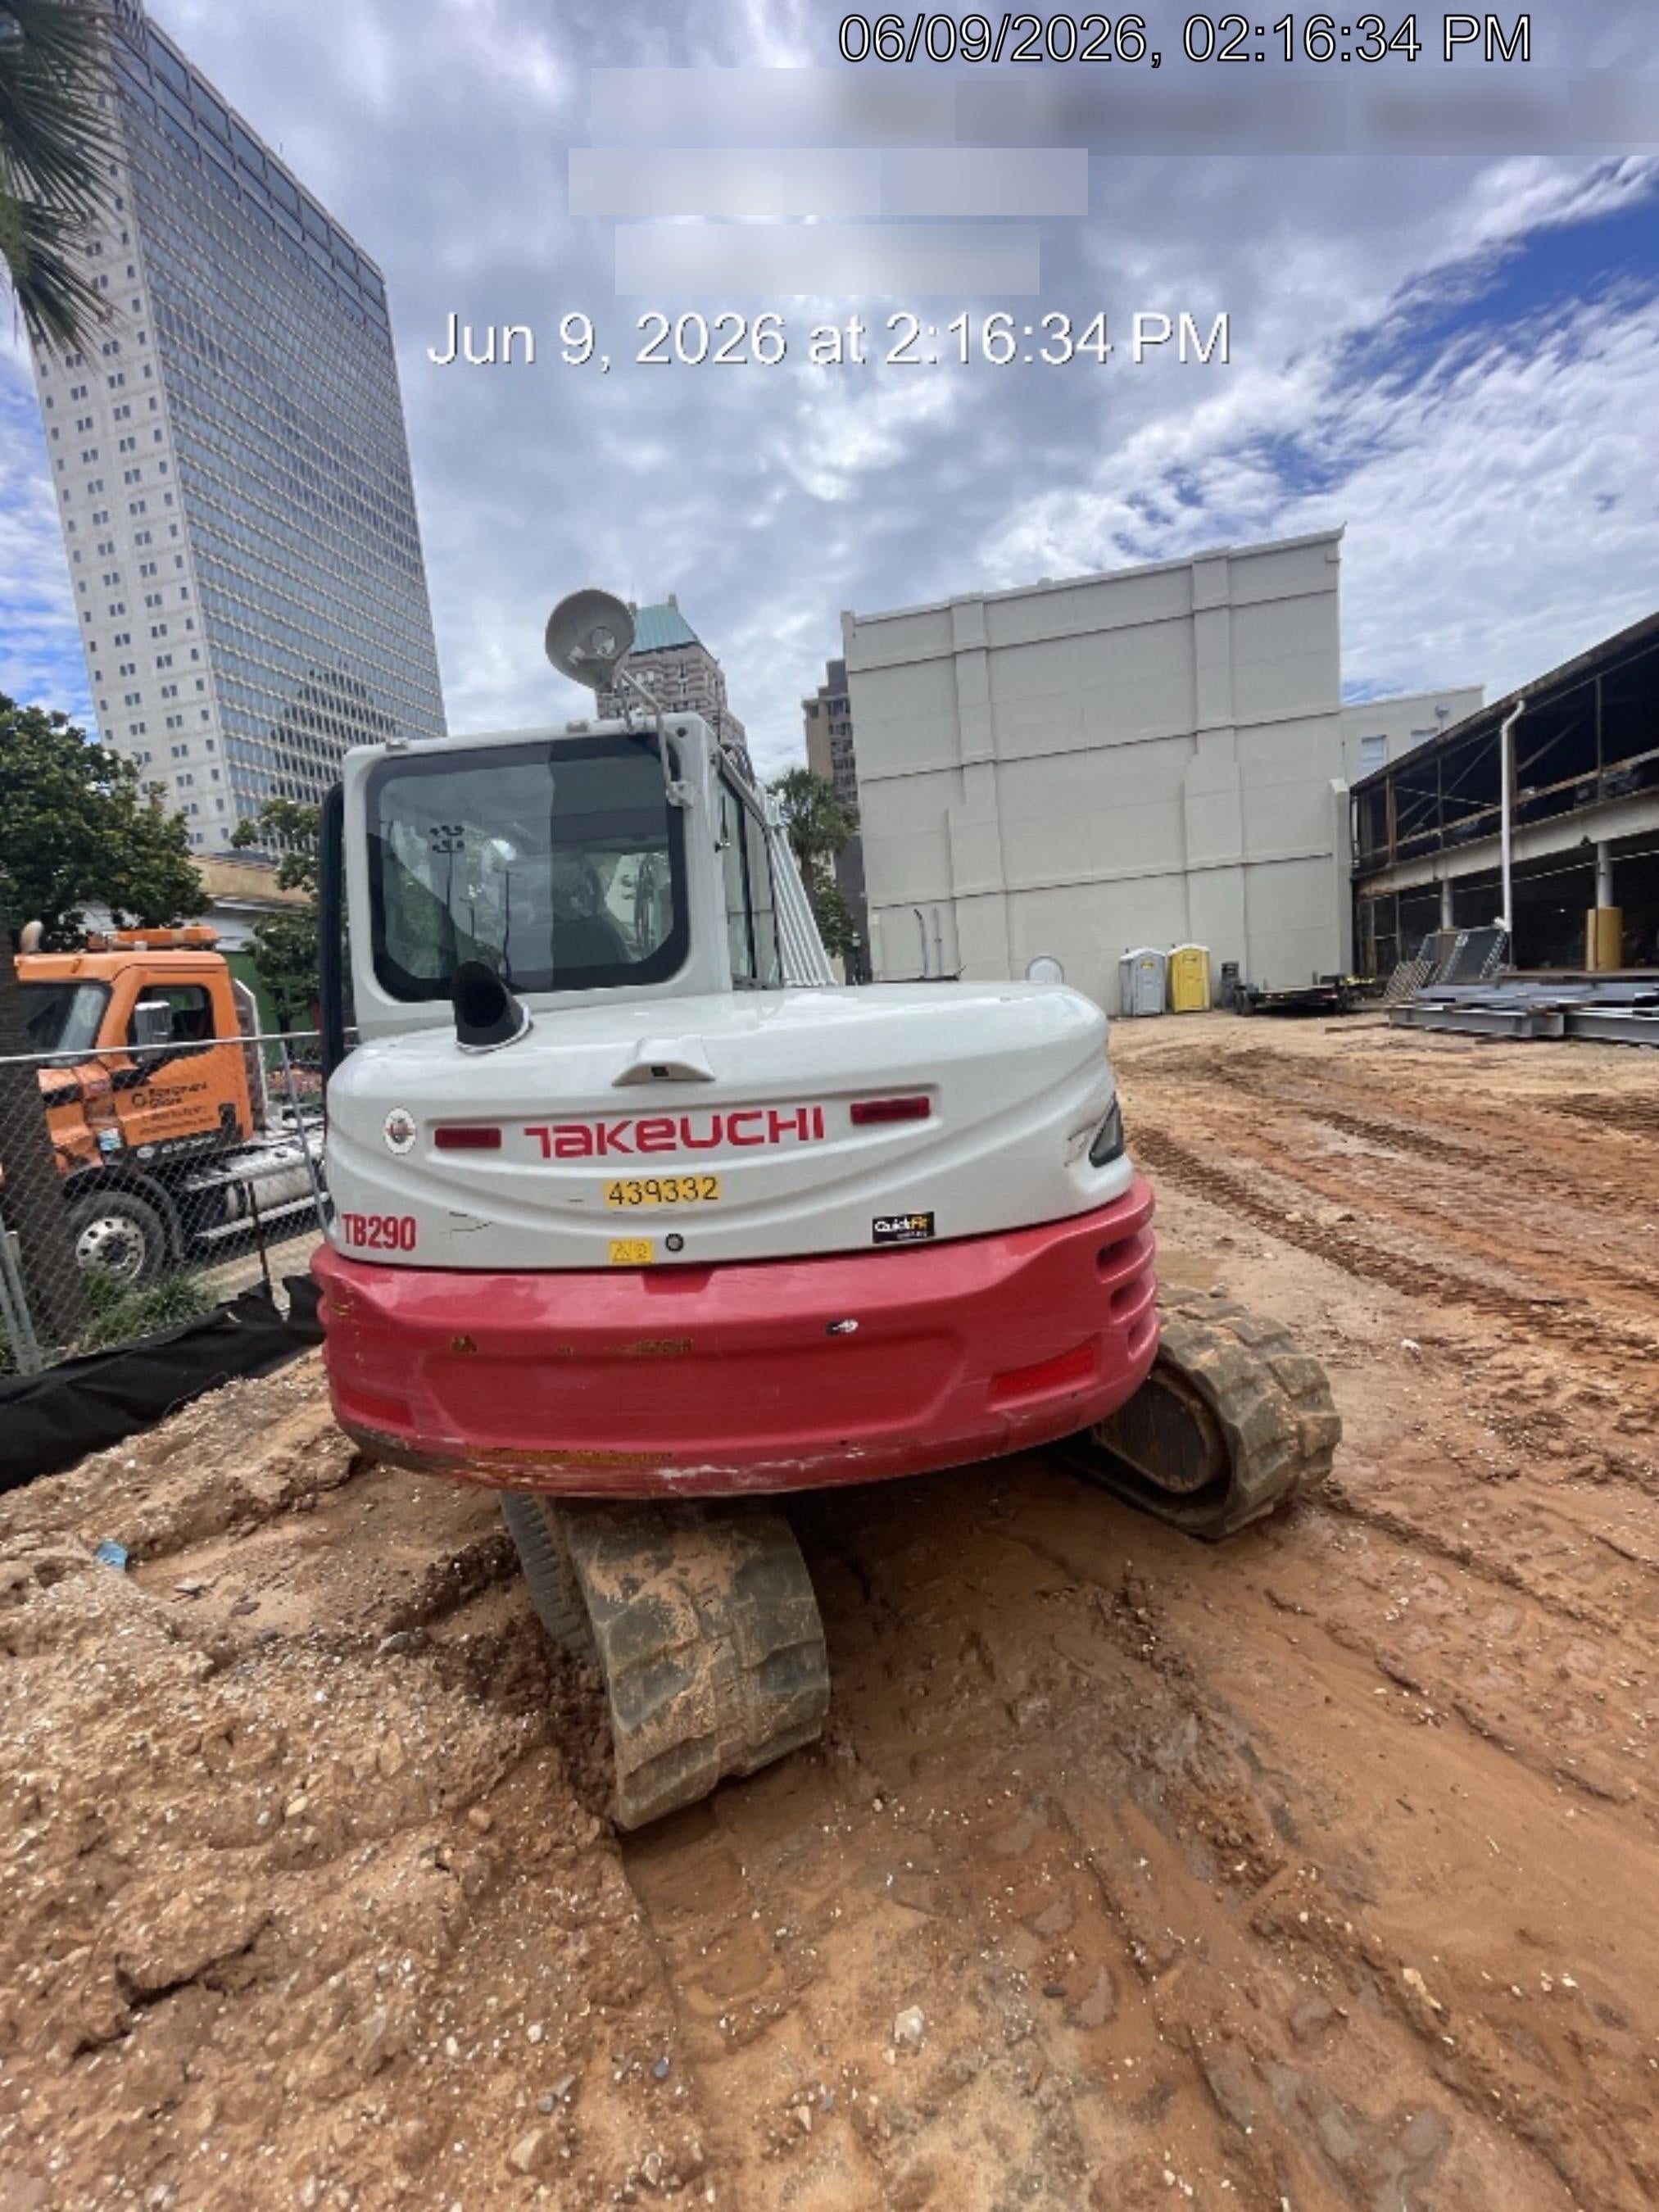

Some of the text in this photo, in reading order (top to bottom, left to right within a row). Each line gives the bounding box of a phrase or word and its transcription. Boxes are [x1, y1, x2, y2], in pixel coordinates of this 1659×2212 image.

[524, 1106, 825, 1158] TAKEUCHI
[609, 1176, 719, 1205] 439332
[342, 1213, 416, 1252] TB290
